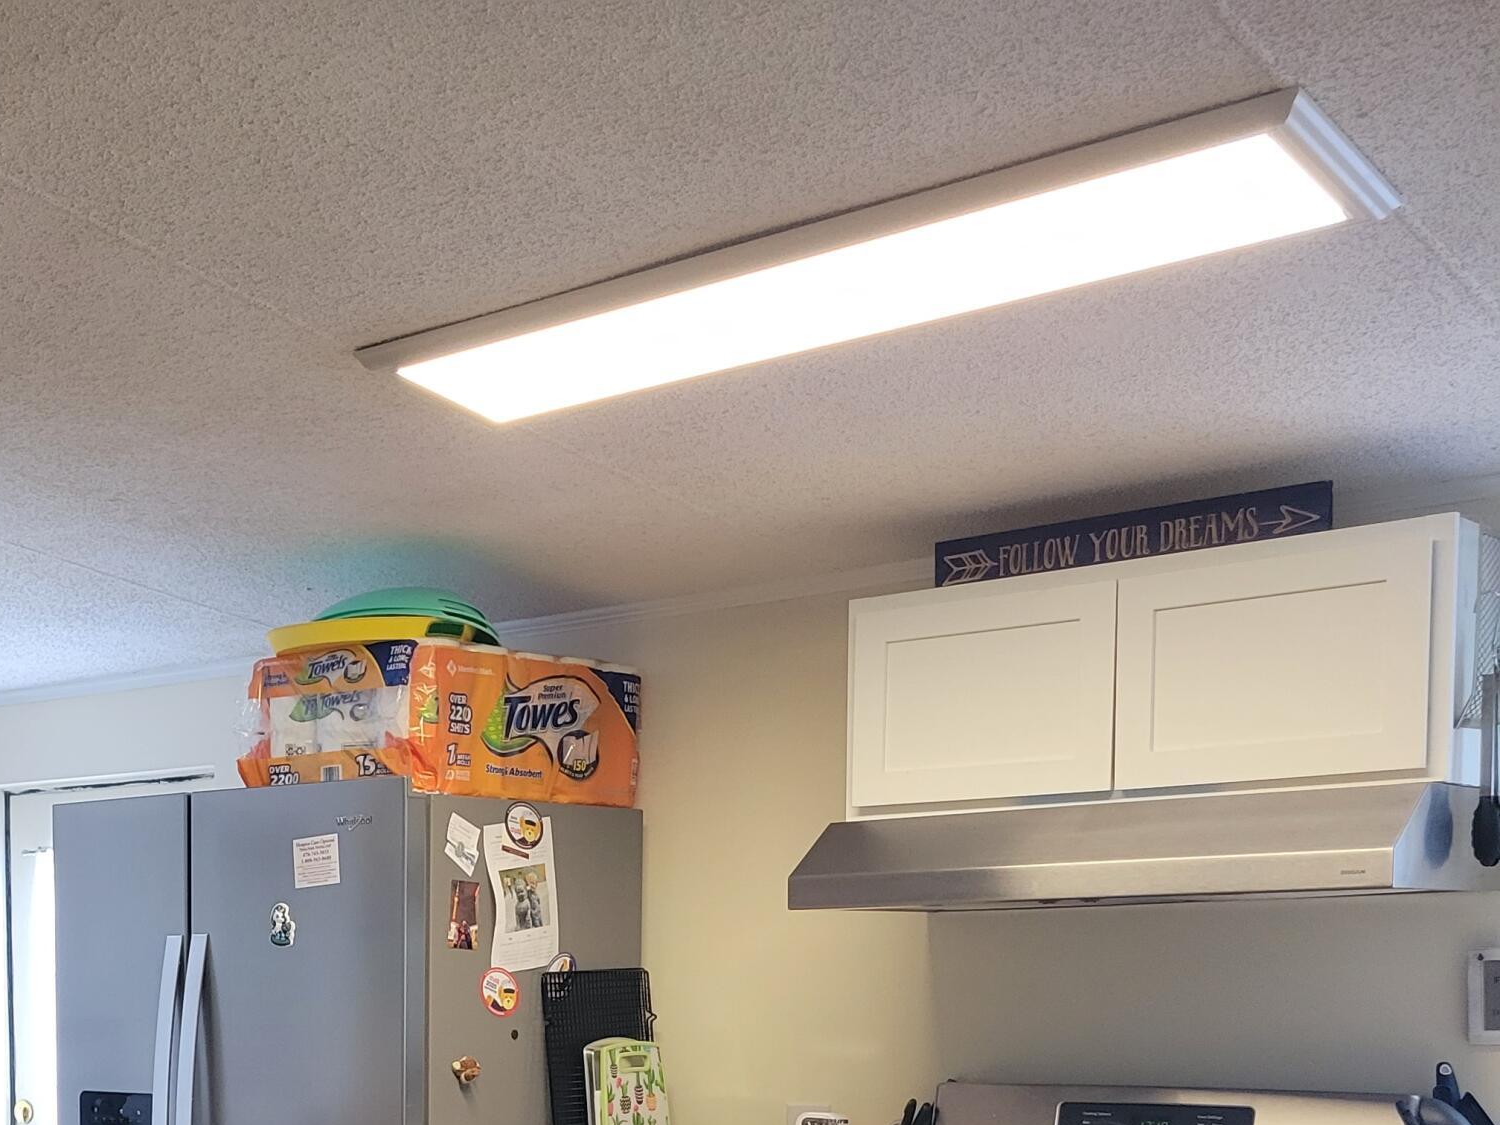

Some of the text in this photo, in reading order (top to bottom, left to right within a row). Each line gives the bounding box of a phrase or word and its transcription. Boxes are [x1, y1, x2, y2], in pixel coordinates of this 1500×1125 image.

[999, 507, 1260, 575] FOLLOW YOUR DREAMS
[307, 656, 348, 680] Towels
[542, 684, 564, 693] Super
[623, 681, 639, 694] THIC
[269, 766, 291, 774] OVER
[355, 754, 377, 777] 15
[485, 764, 504, 775] Strong
[509, 765, 543, 779] Absorbent
[572, 759, 587, 771] 150
[270, 773, 299, 786] 2200
